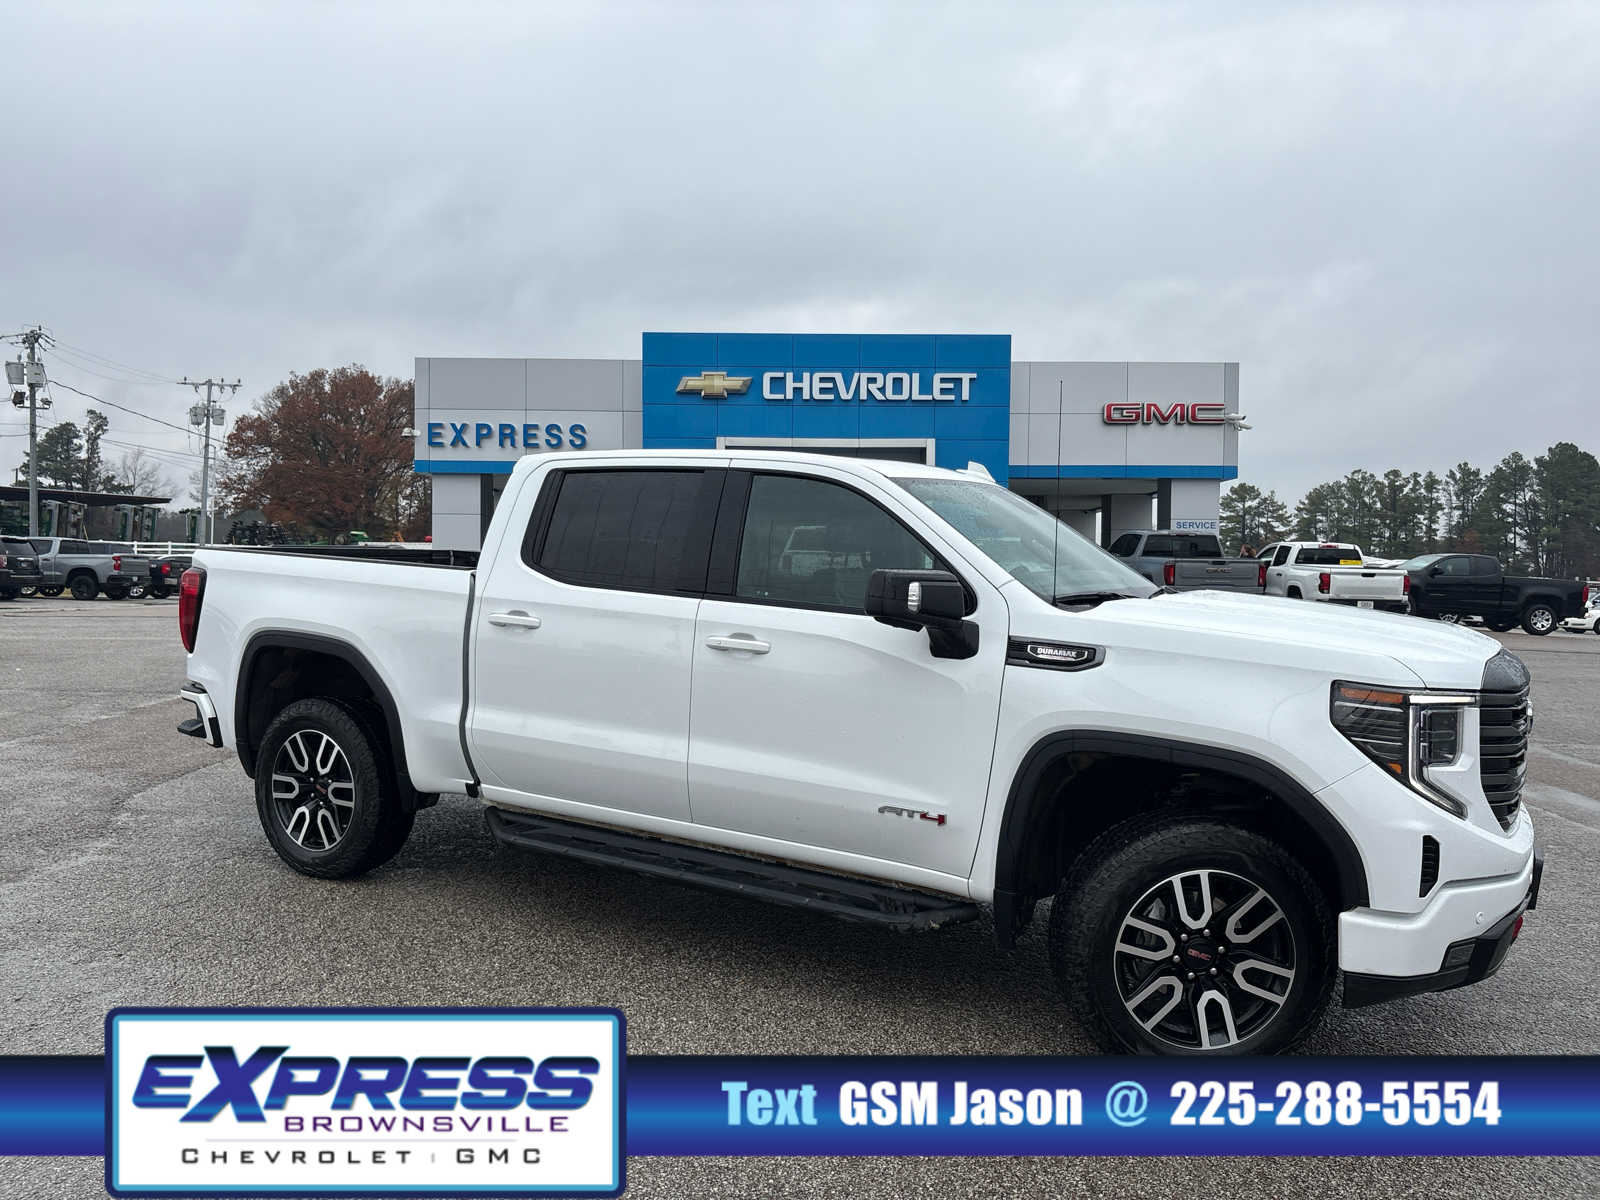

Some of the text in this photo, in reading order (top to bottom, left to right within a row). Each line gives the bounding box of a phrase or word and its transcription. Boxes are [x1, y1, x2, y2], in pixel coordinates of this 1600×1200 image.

[762, 371, 977, 401] CHEVROLET
[1103, 402, 1226, 425] GMC
[427, 422, 589, 449] EXPRESS
[1176, 521, 1217, 529] SERVICE
[1037, 647, 1077, 657] DURAMAX
[878, 805, 947, 826] AT4
